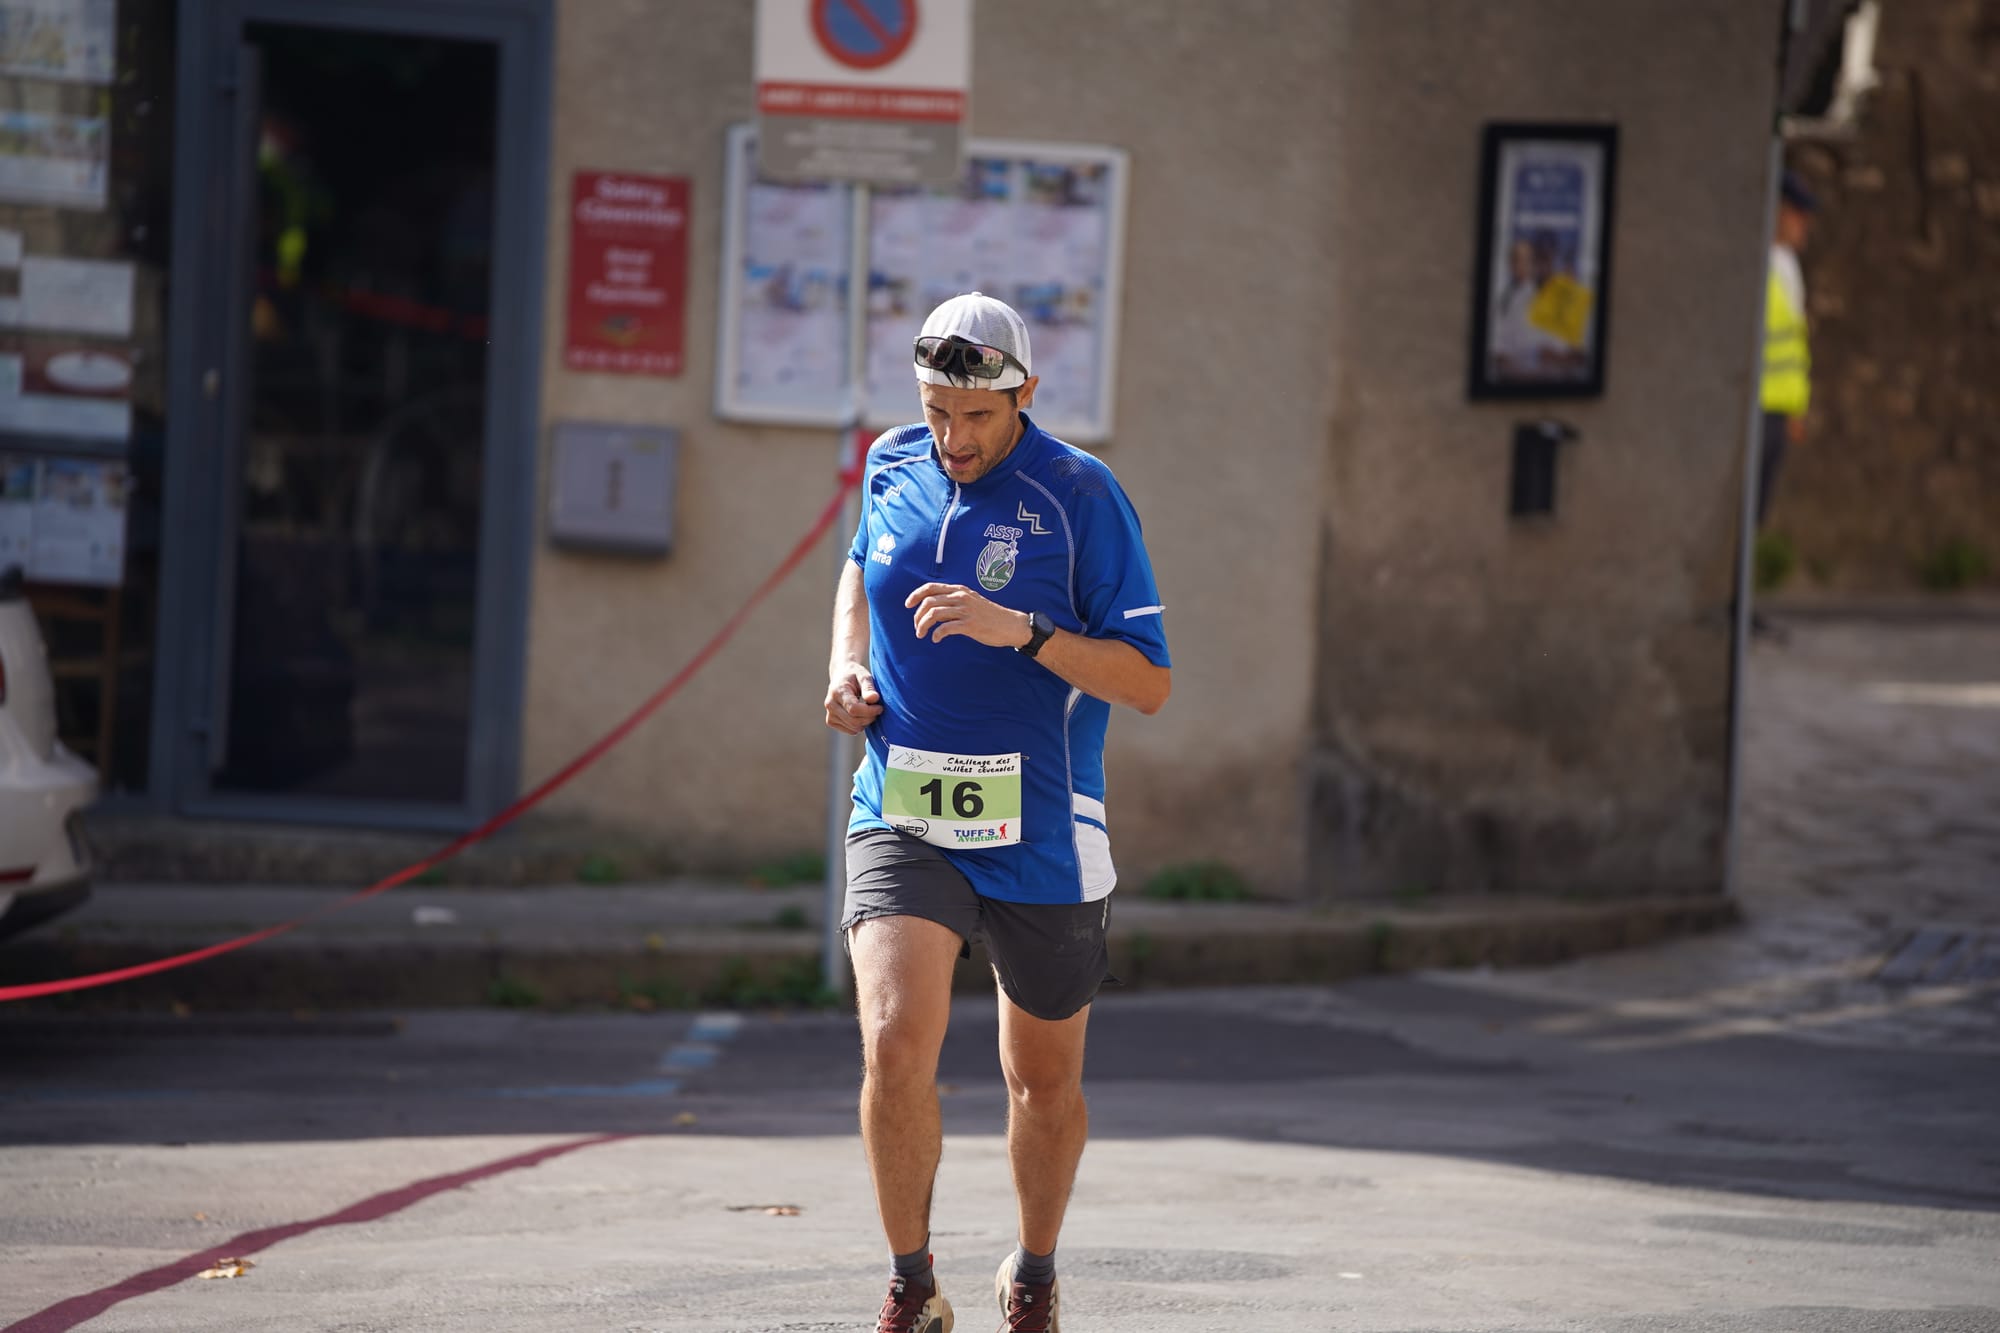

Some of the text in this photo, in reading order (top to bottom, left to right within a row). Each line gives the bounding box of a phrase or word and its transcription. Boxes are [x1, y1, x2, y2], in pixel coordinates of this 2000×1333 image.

[984, 524, 1023, 541] ASSP
[948, 757, 991, 767] Challenge
[942, 765, 973, 773] vallées
[920, 778, 984, 818] 16
[953, 828, 995, 837] TUFF'S
[1024, 1294, 1033, 1303] S
